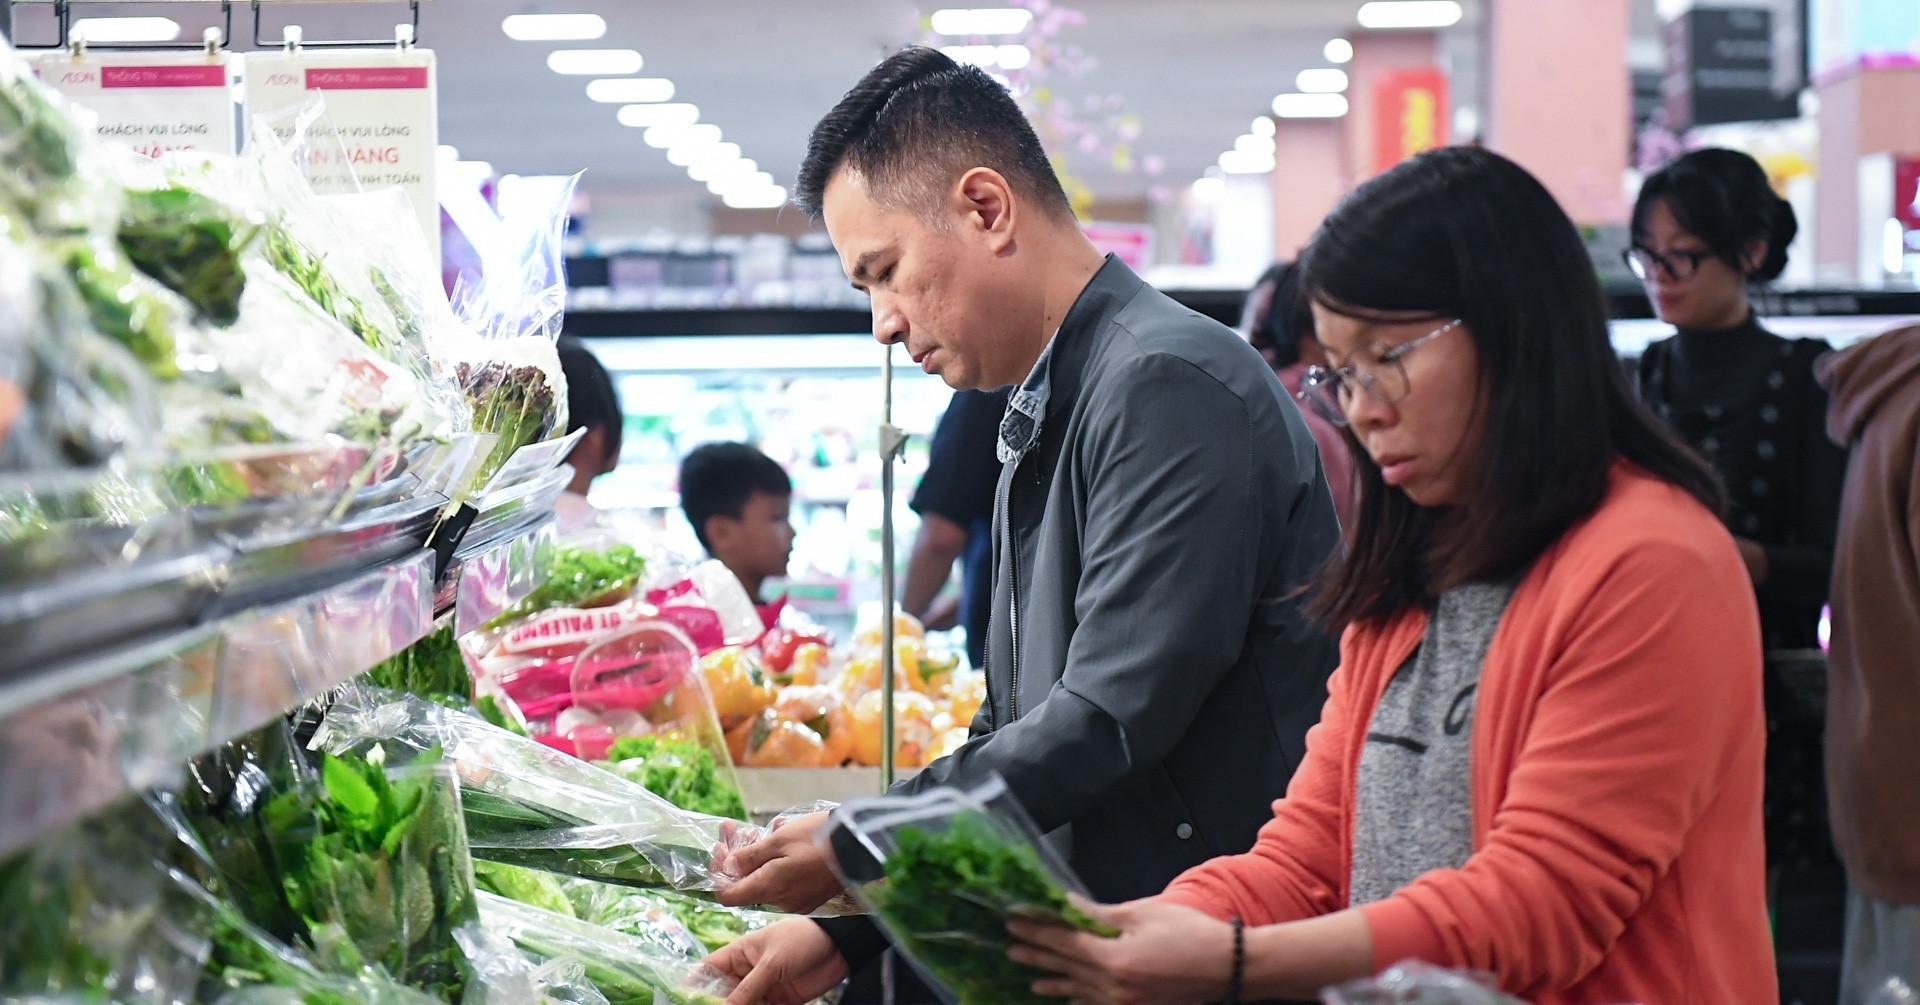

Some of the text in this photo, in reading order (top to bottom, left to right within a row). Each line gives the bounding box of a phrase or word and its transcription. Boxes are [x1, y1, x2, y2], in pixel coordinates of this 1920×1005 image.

[149, 123, 168, 135] VUI
[171, 120, 209, 135] LÒNG
[351, 126, 373, 137] VUI
[375, 123, 411, 137] LÒNG
[335, 143, 400, 164] HÀNG
[385, 171, 421, 184] TOÁN
